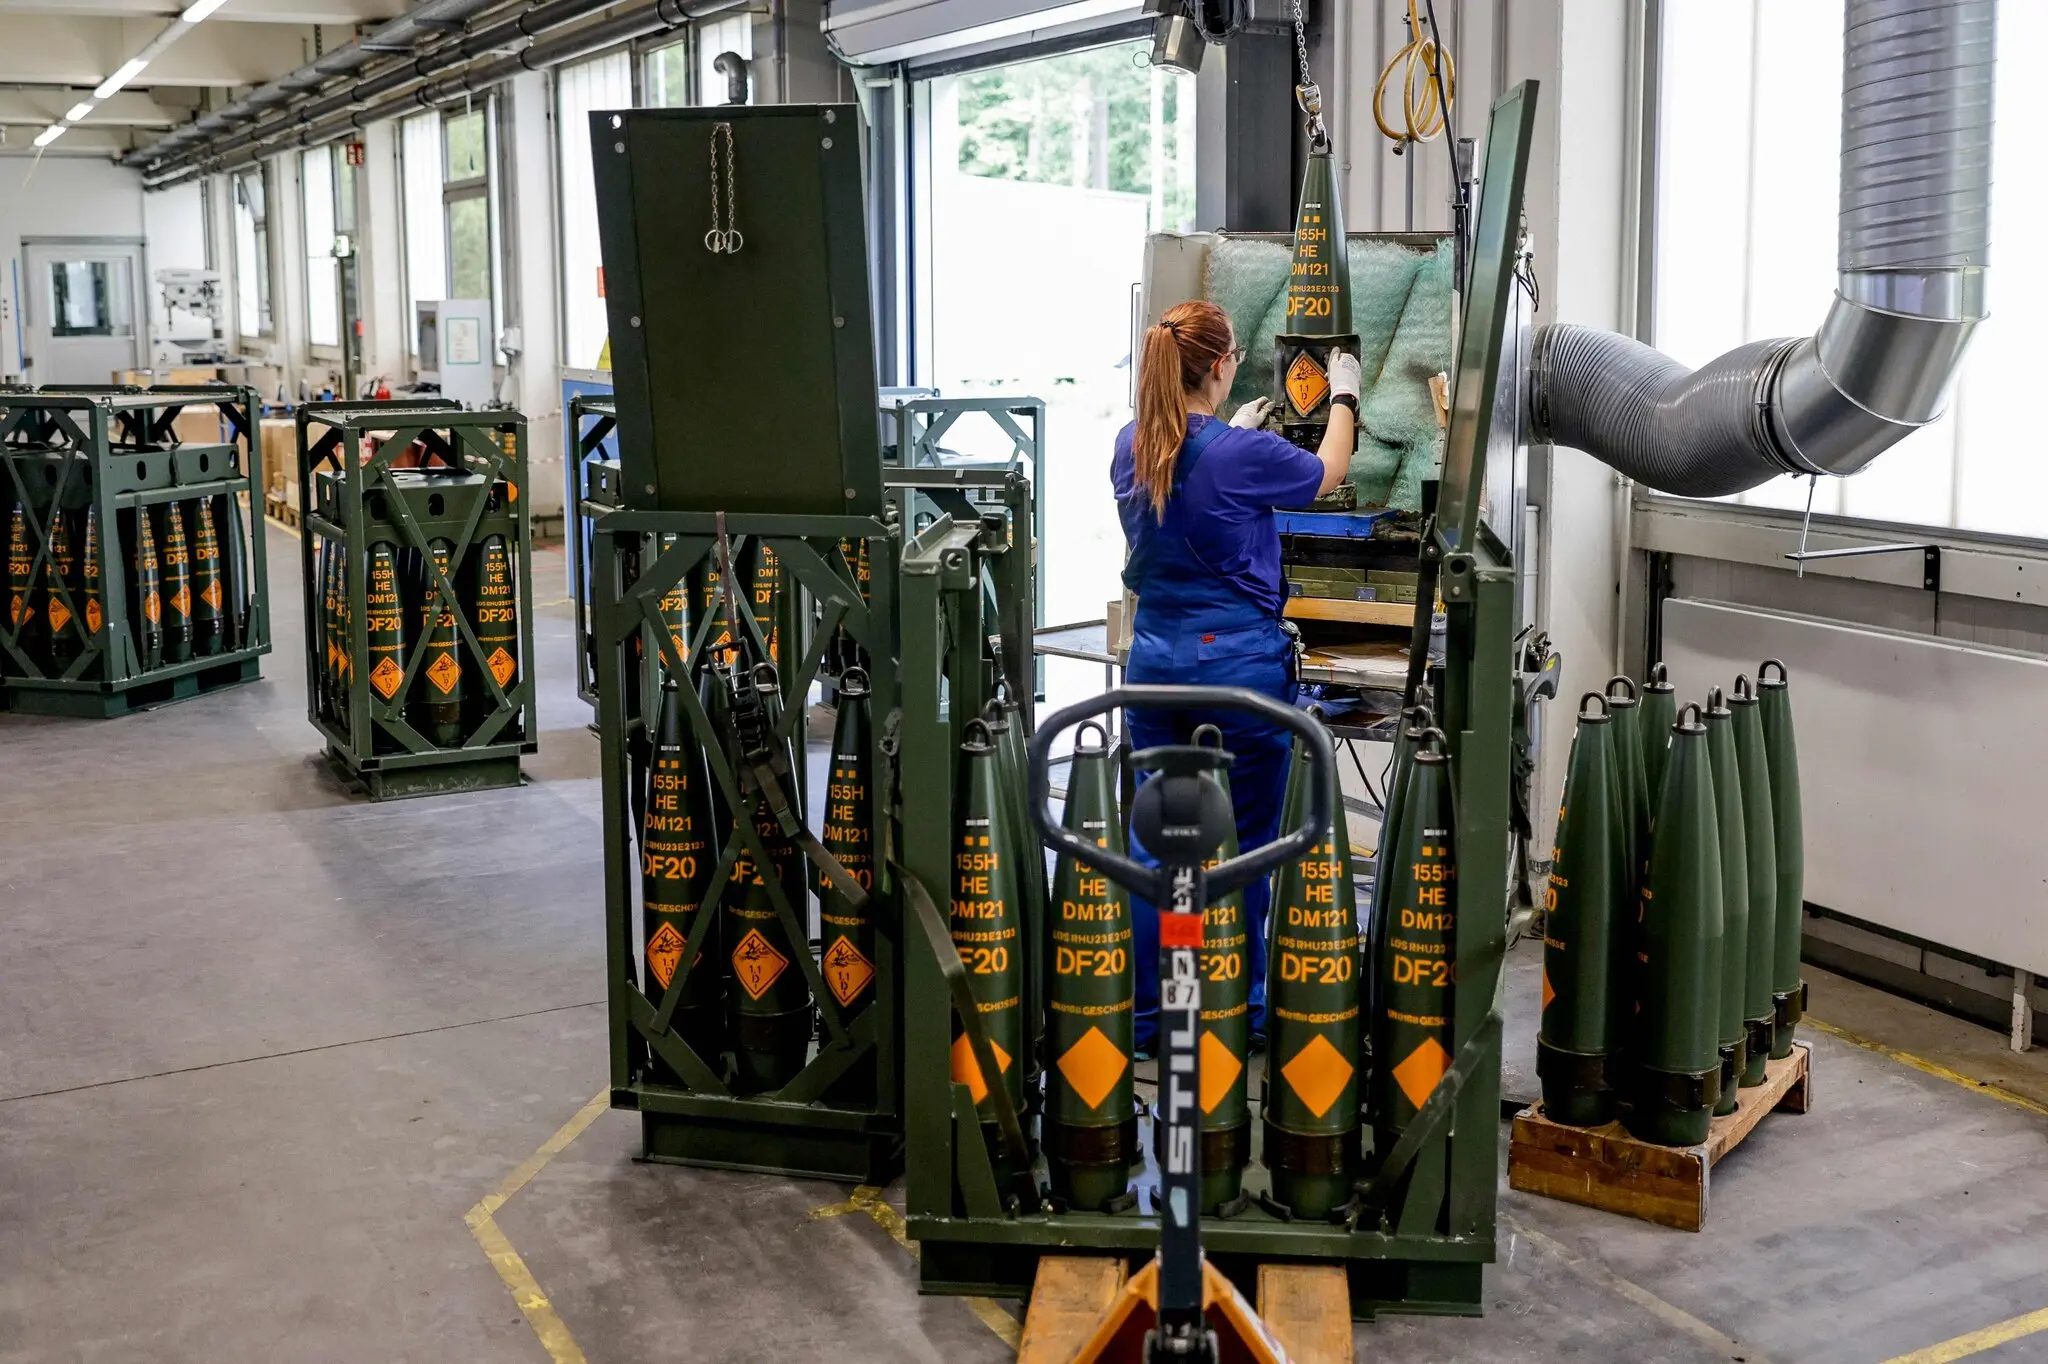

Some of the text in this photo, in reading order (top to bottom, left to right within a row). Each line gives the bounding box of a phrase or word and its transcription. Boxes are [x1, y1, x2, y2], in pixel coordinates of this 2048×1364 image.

[1298, 228, 1326, 241] 155H
[1299, 244, 1318, 258] HE
[1288, 296, 1331, 316] DF20
[1302, 392, 1308, 400] D
[372, 569, 394, 580] 155H
[485, 562, 507, 572] 155H
[489, 573, 504, 582] HE
[376, 582, 391, 591] HE
[481, 585, 510, 596] DM121
[367, 593, 398, 604] DM121
[658, 597, 688, 612] DF20
[478, 608, 514, 622] DF20
[367, 616, 402, 632] DF20
[653, 776, 687, 790] 155H
[830, 784, 864, 800] 155H
[656, 794, 678, 810] HE
[832, 804, 854, 820] HE
[645, 812, 692, 832] DM121
[824, 824, 868, 842] DM121
[644, 853, 696, 880] DF20
[956, 852, 999, 871] 155H
[1298, 860, 1342, 880] 155H
[1412, 863, 1455, 882] 155H
[960, 876, 989, 894] HE
[1080, 878, 1107, 896] HE
[1306, 884, 1334, 903] HE
[1419, 887, 1447, 906] HE
[1063, 901, 1121, 921] DM121
[1200, 906, 1237, 925] M121
[1288, 906, 1348, 928] DM121
[1278, 935, 1296, 948] LOS
[1390, 938, 1408, 950] LOS
[663, 958, 674, 966] 1.1
[958, 946, 1008, 974] F20
[1056, 946, 1126, 976] DF20
[1281, 952, 1352, 984] DF20
[666, 967, 674, 976] D
[750, 964, 761, 974] 1.1
[838, 971, 850, 981] 1.1
[752, 974, 760, 983] D
[840, 982, 848, 991] D
